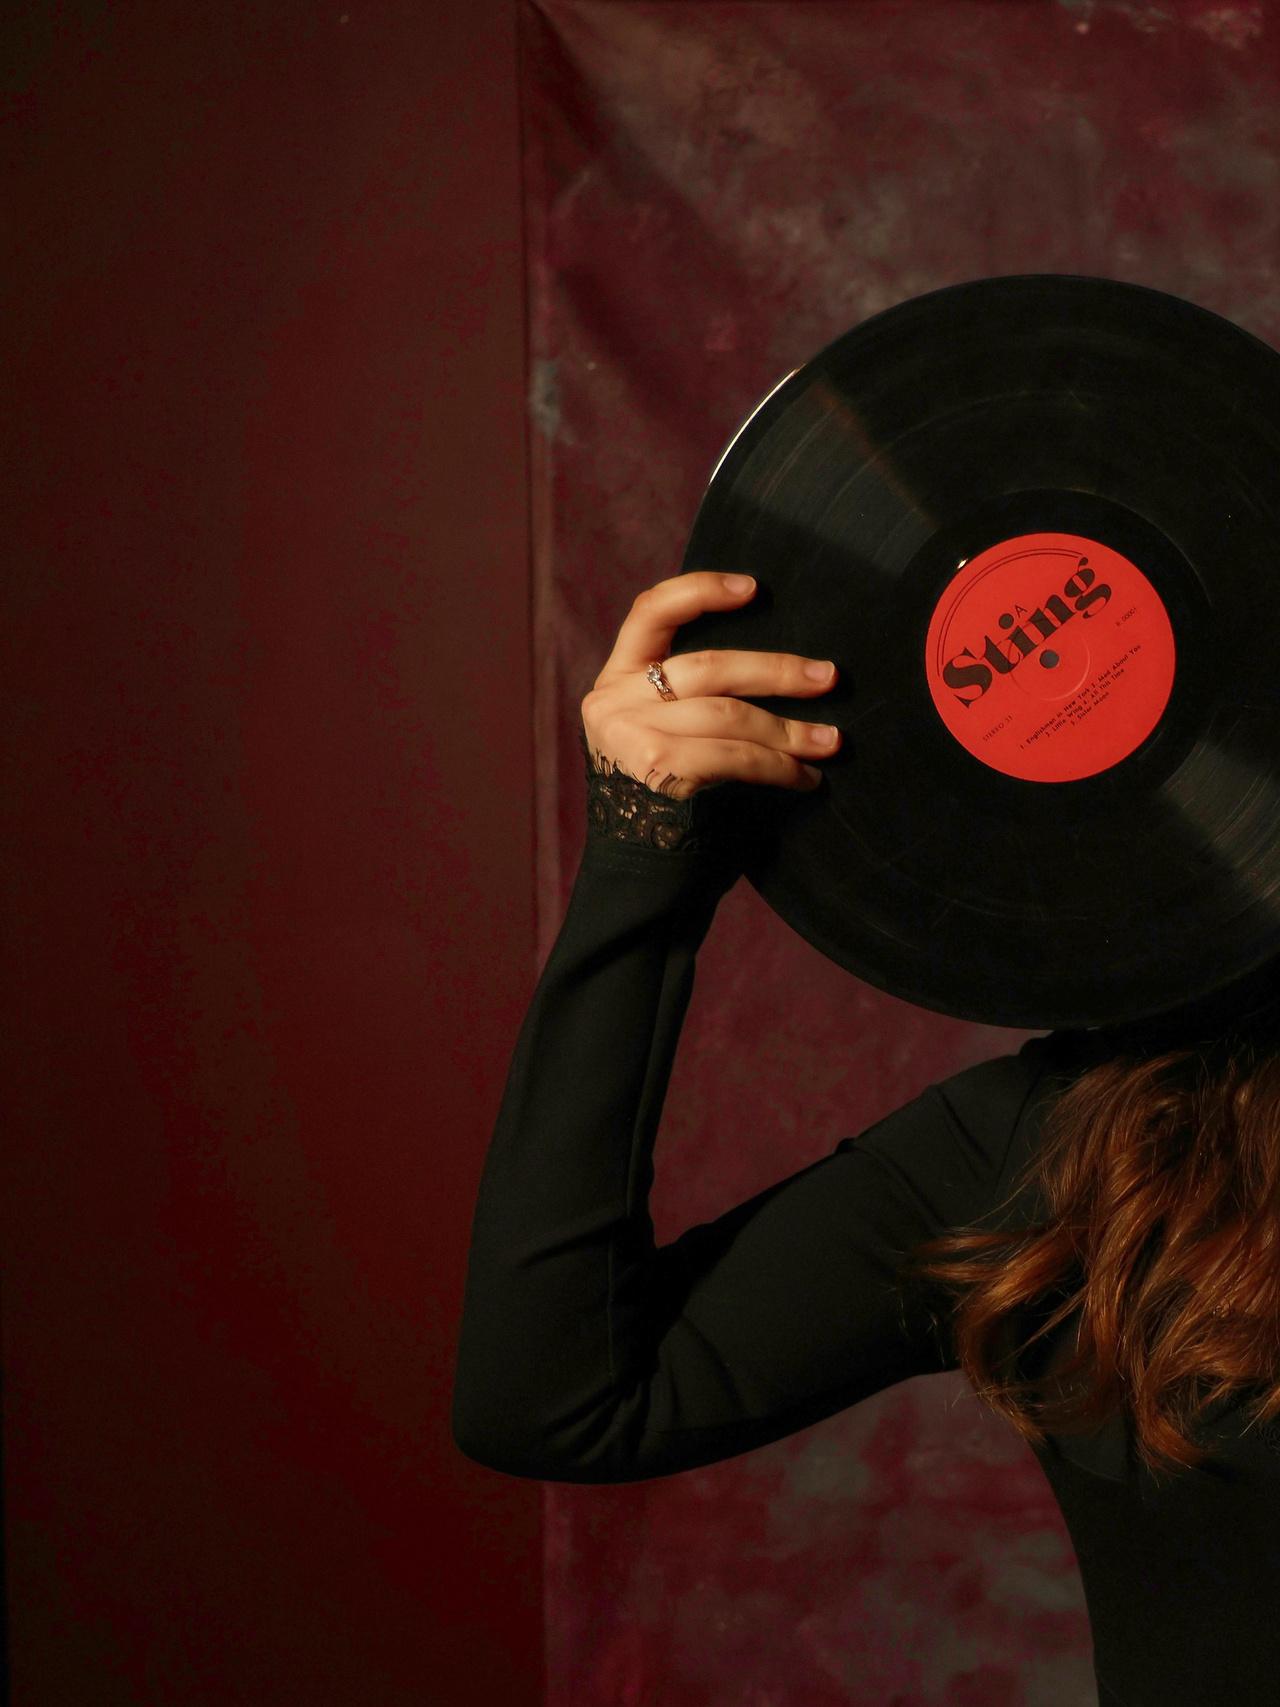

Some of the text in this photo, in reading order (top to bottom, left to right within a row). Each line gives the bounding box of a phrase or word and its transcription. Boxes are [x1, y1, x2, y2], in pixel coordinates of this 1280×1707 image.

[943, 557, 1111, 709] Sting
[1015, 605, 1027, 618] A
[1026, 718, 1056, 744] Englishman
[1064, 700, 1076, 711] New
[1077, 688, 1090, 700] York
[1098, 669, 1111, 682] Mad
[1112, 654, 1128, 670] About
[1129, 644, 1141, 655] You
[1052, 719, 1067, 732] Little
[1067, 705, 1083, 718] Wing
[1091, 690, 1099, 699] All
[1099, 681, 1111, 690] This
[1111, 668, 1125, 680] Time
[1077, 706, 1092, 720] Sister
[1093, 691, 1110, 706] Moon
[982, 722, 1004, 742] STEREO
